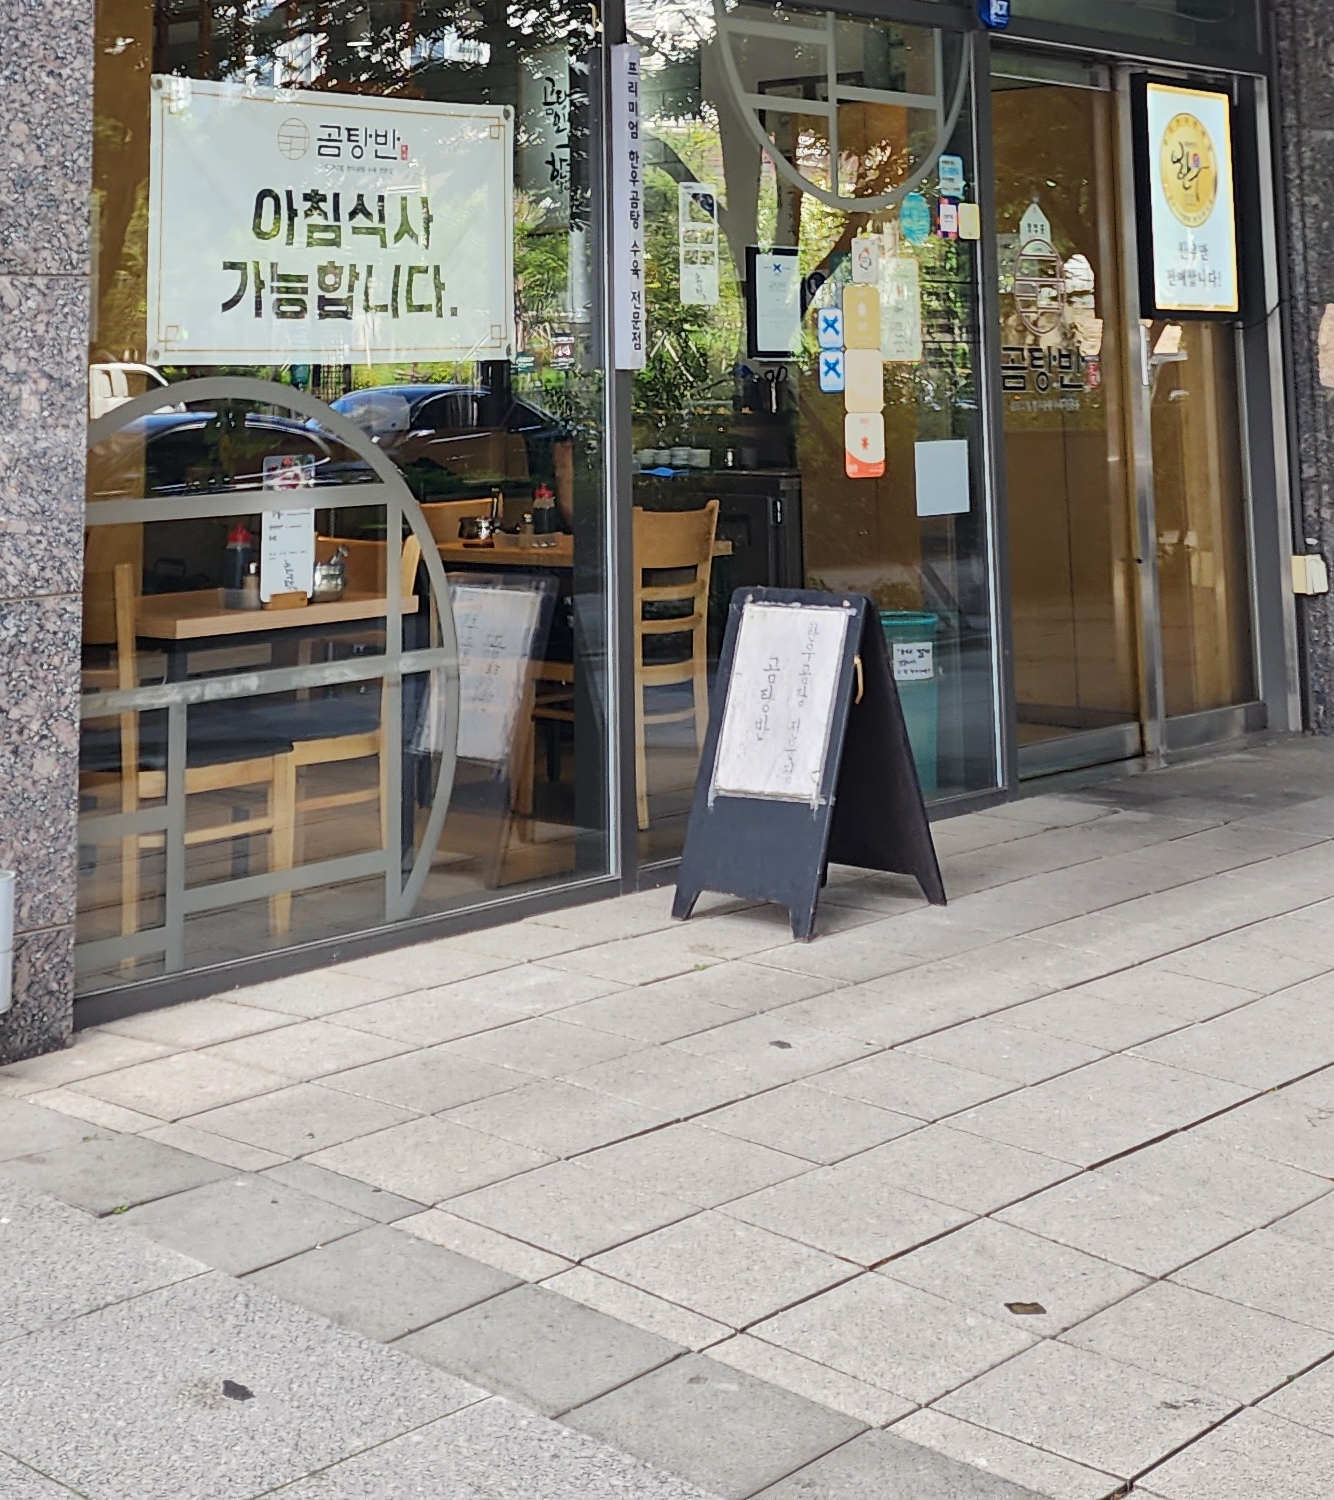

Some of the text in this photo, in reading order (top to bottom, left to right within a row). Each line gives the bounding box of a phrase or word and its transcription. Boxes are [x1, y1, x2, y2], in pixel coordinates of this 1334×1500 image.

[317, 125, 401, 160] 곰탕반
[251, 187, 434, 250] 아침식사
[627, 61, 643, 352] 프리미엄 한우곰탕 수육 전문점
[222, 259, 458, 320] 가능합니다.
[1001, 345, 1085, 393] 곰탕반
